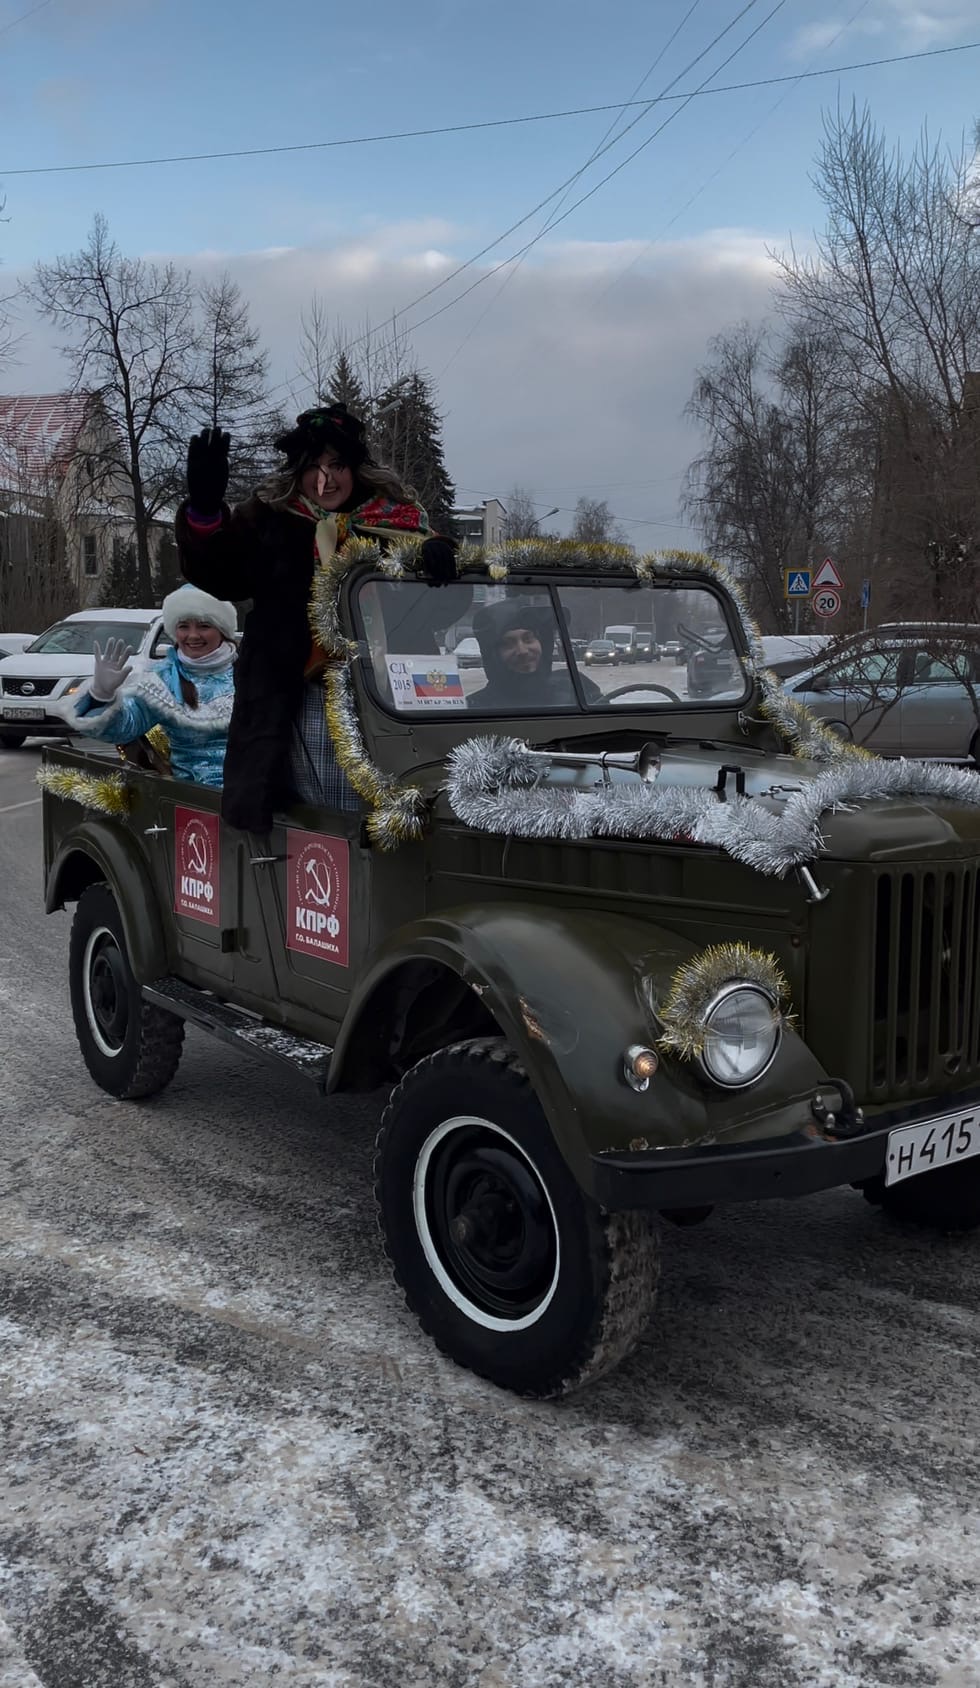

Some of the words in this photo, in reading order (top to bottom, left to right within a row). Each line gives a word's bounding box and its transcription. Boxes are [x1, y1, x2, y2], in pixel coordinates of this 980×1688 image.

[820, 597, 835, 609] 20
[393, 679, 412, 691] 2015
[181, 875, 214, 903] КПРФ
[295, 906, 340, 938] КПРФ
[305, 936, 340, 954] БАЛАШИХА
